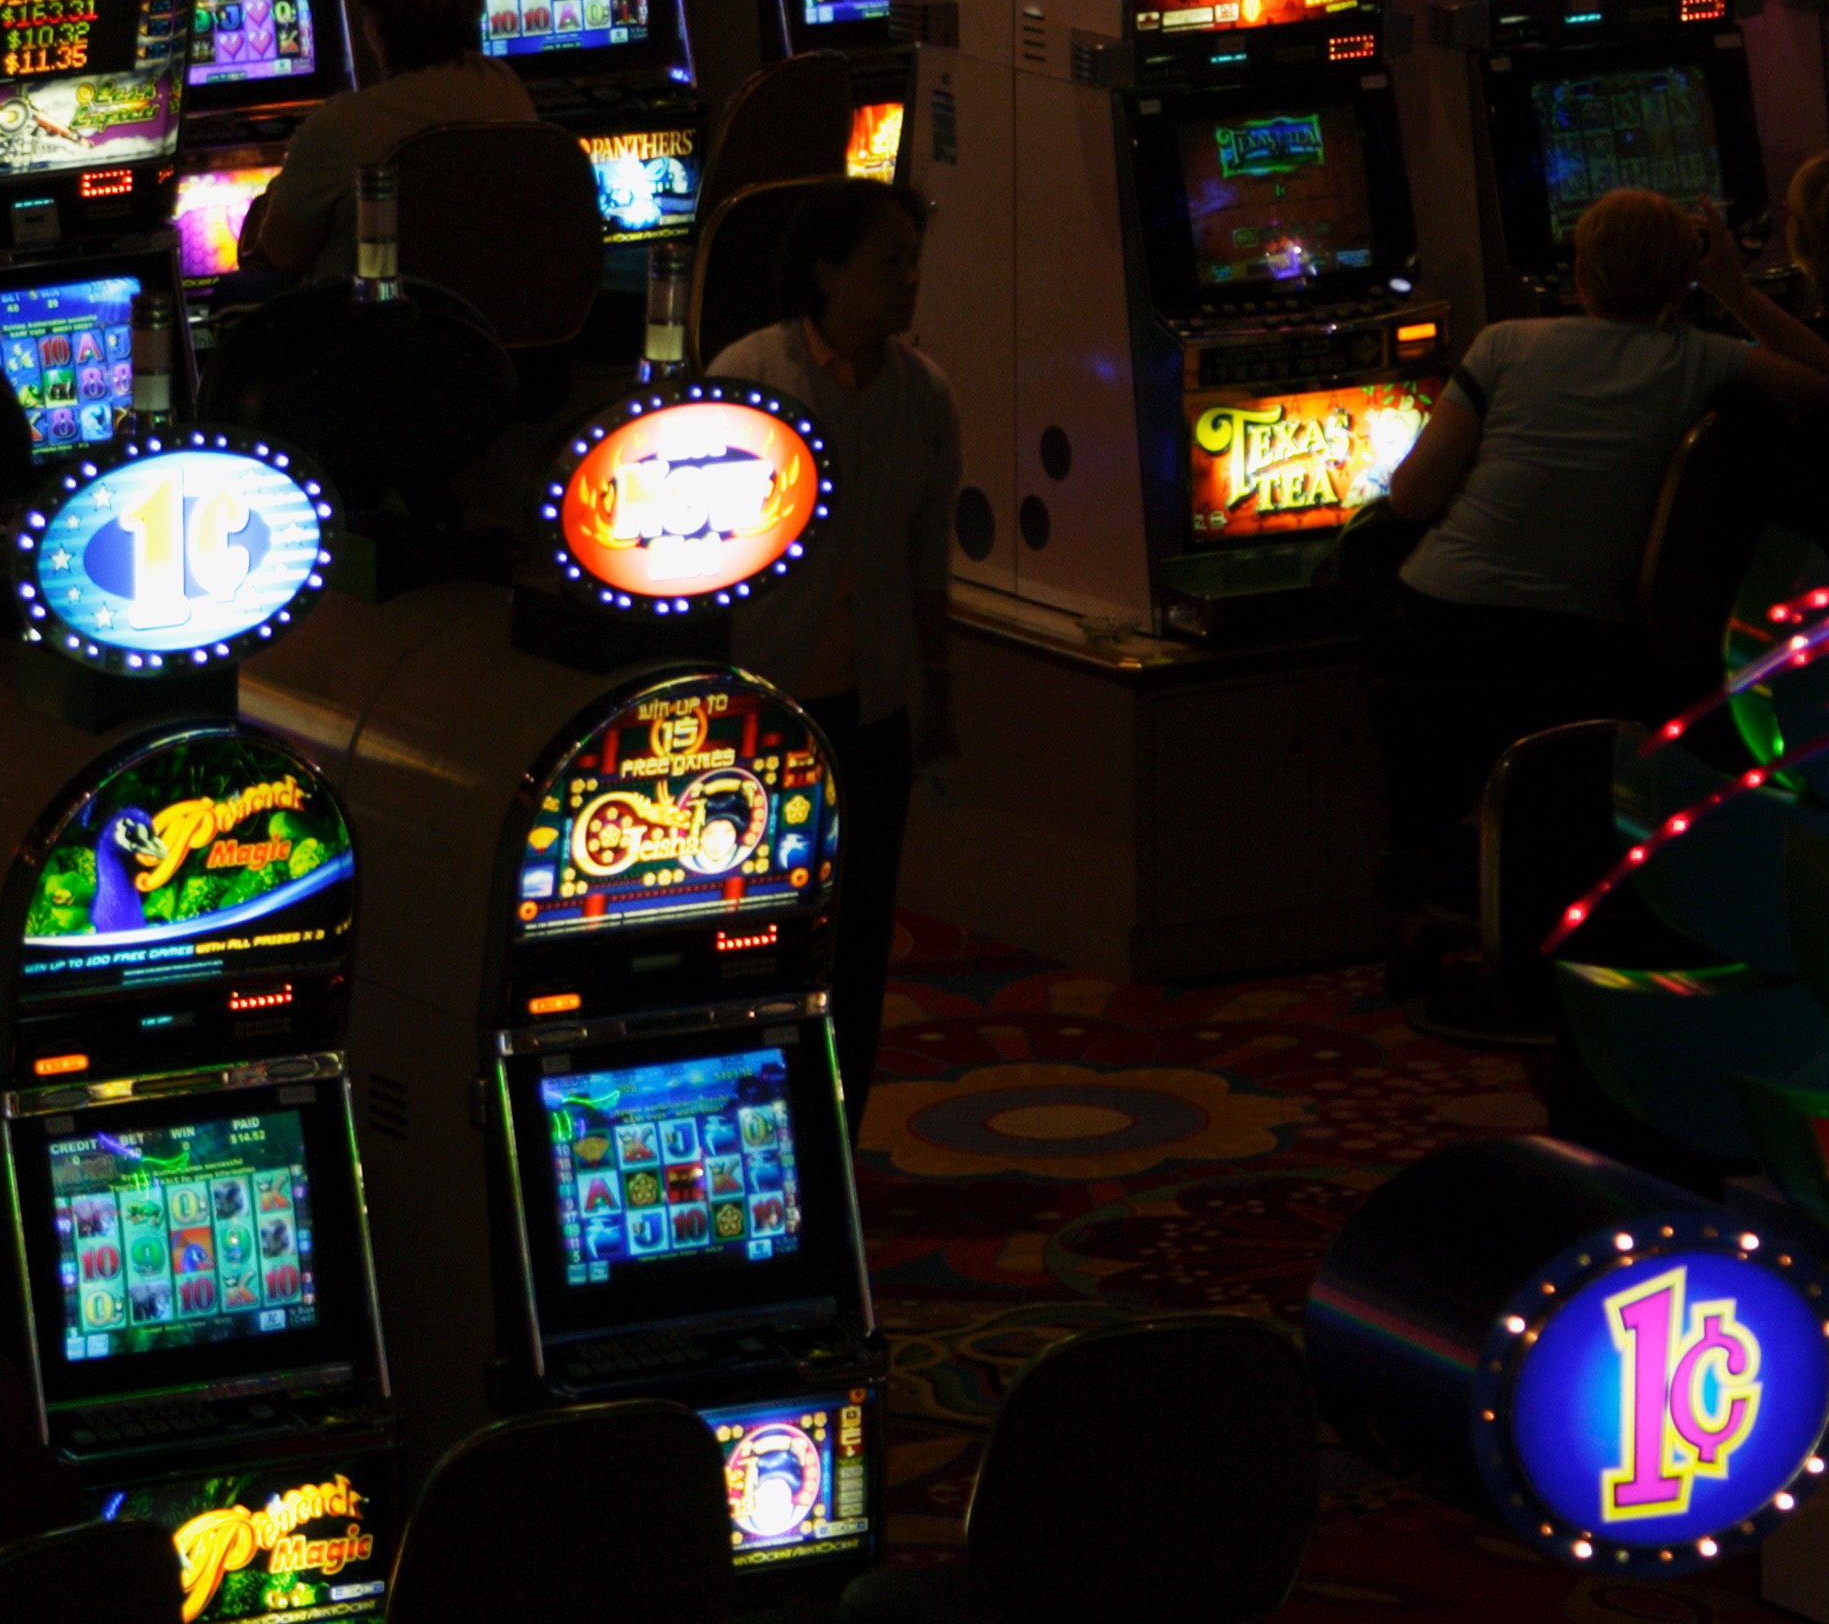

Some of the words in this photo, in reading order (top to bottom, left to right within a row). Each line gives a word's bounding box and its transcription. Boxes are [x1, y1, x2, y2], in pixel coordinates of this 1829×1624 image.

[6, 22, 91, 52] $10.32
[3, 43, 88, 75] $11.35
[93, 81, 159, 108] Cash
[72, 106, 160, 133] Express
[591, 130, 693, 159] PANTHERS
[1194, 402, 1352, 511] TEXAS
[1252, 467, 1340, 514] TEA
[675, 698, 701, 717] UP
[703, 693, 729, 714] TO
[621, 752, 668, 779] FREE
[670, 748, 737, 774] GAMES
[134, 773, 313, 893] Peacock
[207, 836, 292, 872] Magic
[24, 960, 50, 975] WIN
[51, 959, 66, 973] UP
[67, 958, 84, 971] TO
[112, 950, 148, 966] FREE
[150, 945, 194, 963] GAMES
[195, 940, 227, 957] WITH
[227, 938, 251, 951] ALL
[253, 931, 301, 950] PRIZES
[49, 1137, 101, 1156] CREDIT
[672, 1206, 710, 1243] 10
[78, 1246, 121, 1281] 10
[178, 1279, 218, 1316] 10
[1601, 1266, 1763, 1522] 1¢
[173, 1473, 365, 1624] Peacock
[269, 1524, 374, 1576] Magic
